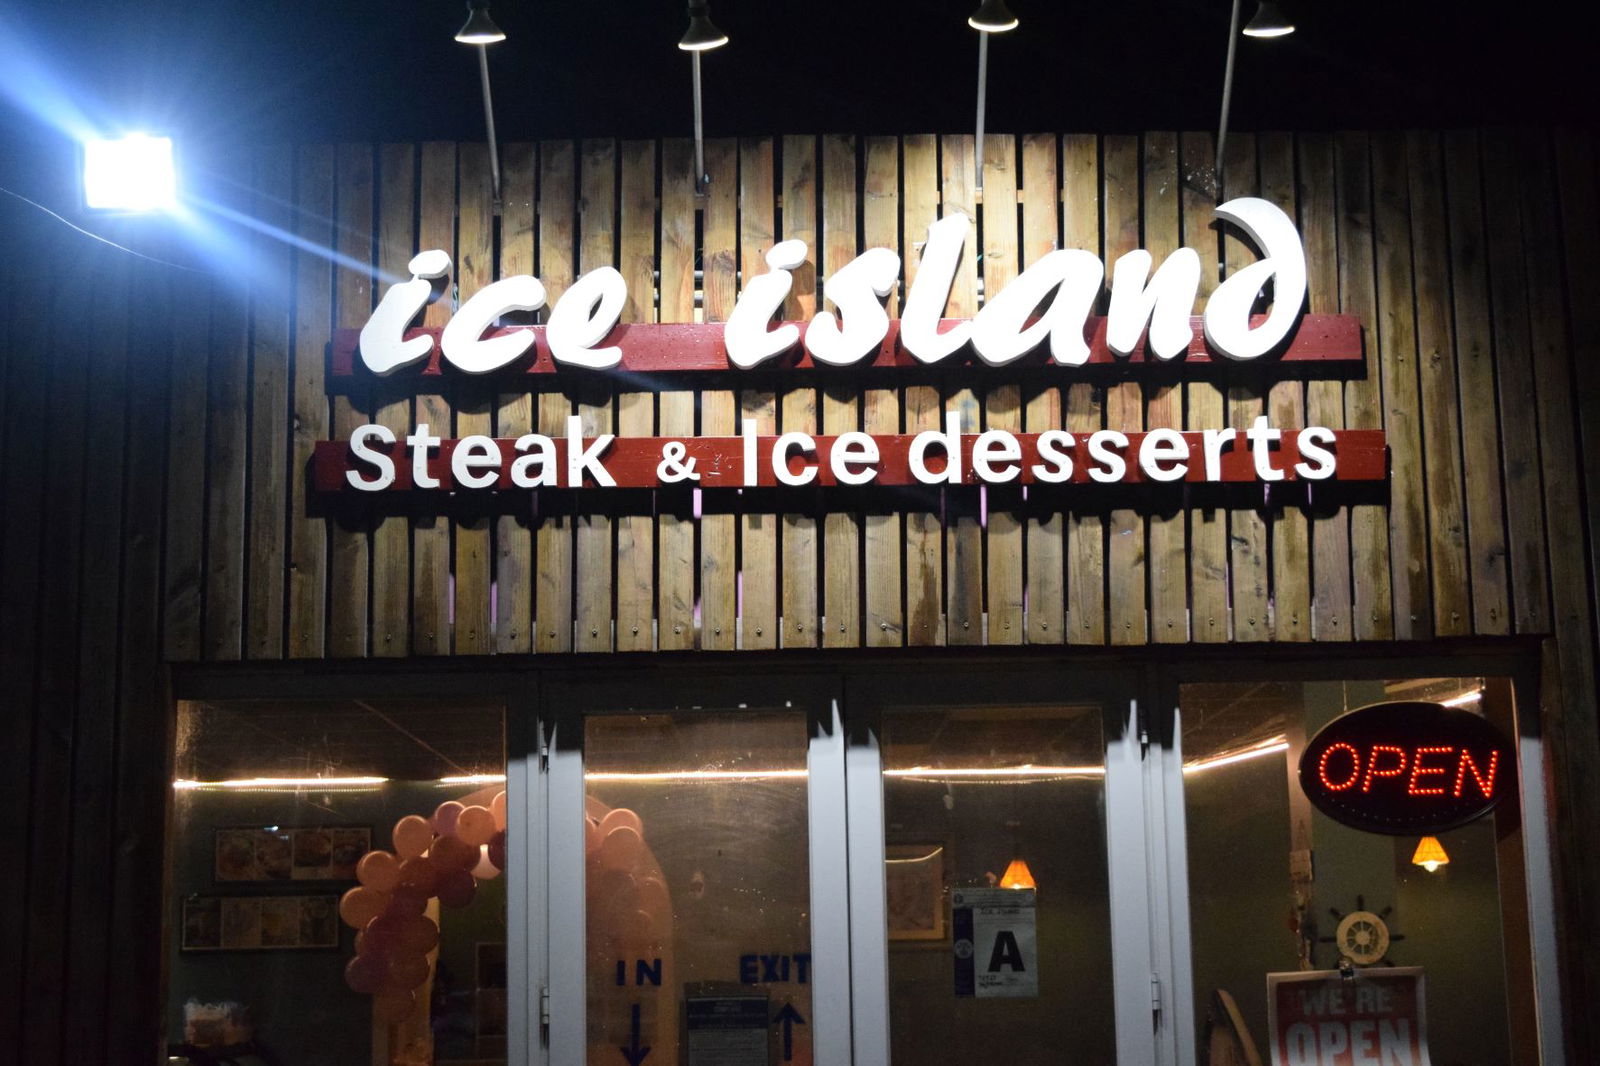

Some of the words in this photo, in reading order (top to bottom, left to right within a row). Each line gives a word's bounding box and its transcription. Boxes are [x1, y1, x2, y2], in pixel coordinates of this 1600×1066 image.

[359, 249, 627, 376] ice
[724, 197, 1306, 371] island
[345, 415, 617, 491] Steak
[656, 441, 700, 483] &
[743, 418, 880, 486] Ice
[908, 411, 1338, 485] desserts
[1319, 741, 1499, 798] OPEN
[616, 958, 662, 986] IN
[740, 952, 811, 984] EXIT
[987, 931, 1026, 972] A
[1285, 1017, 1414, 1066] OPEN
